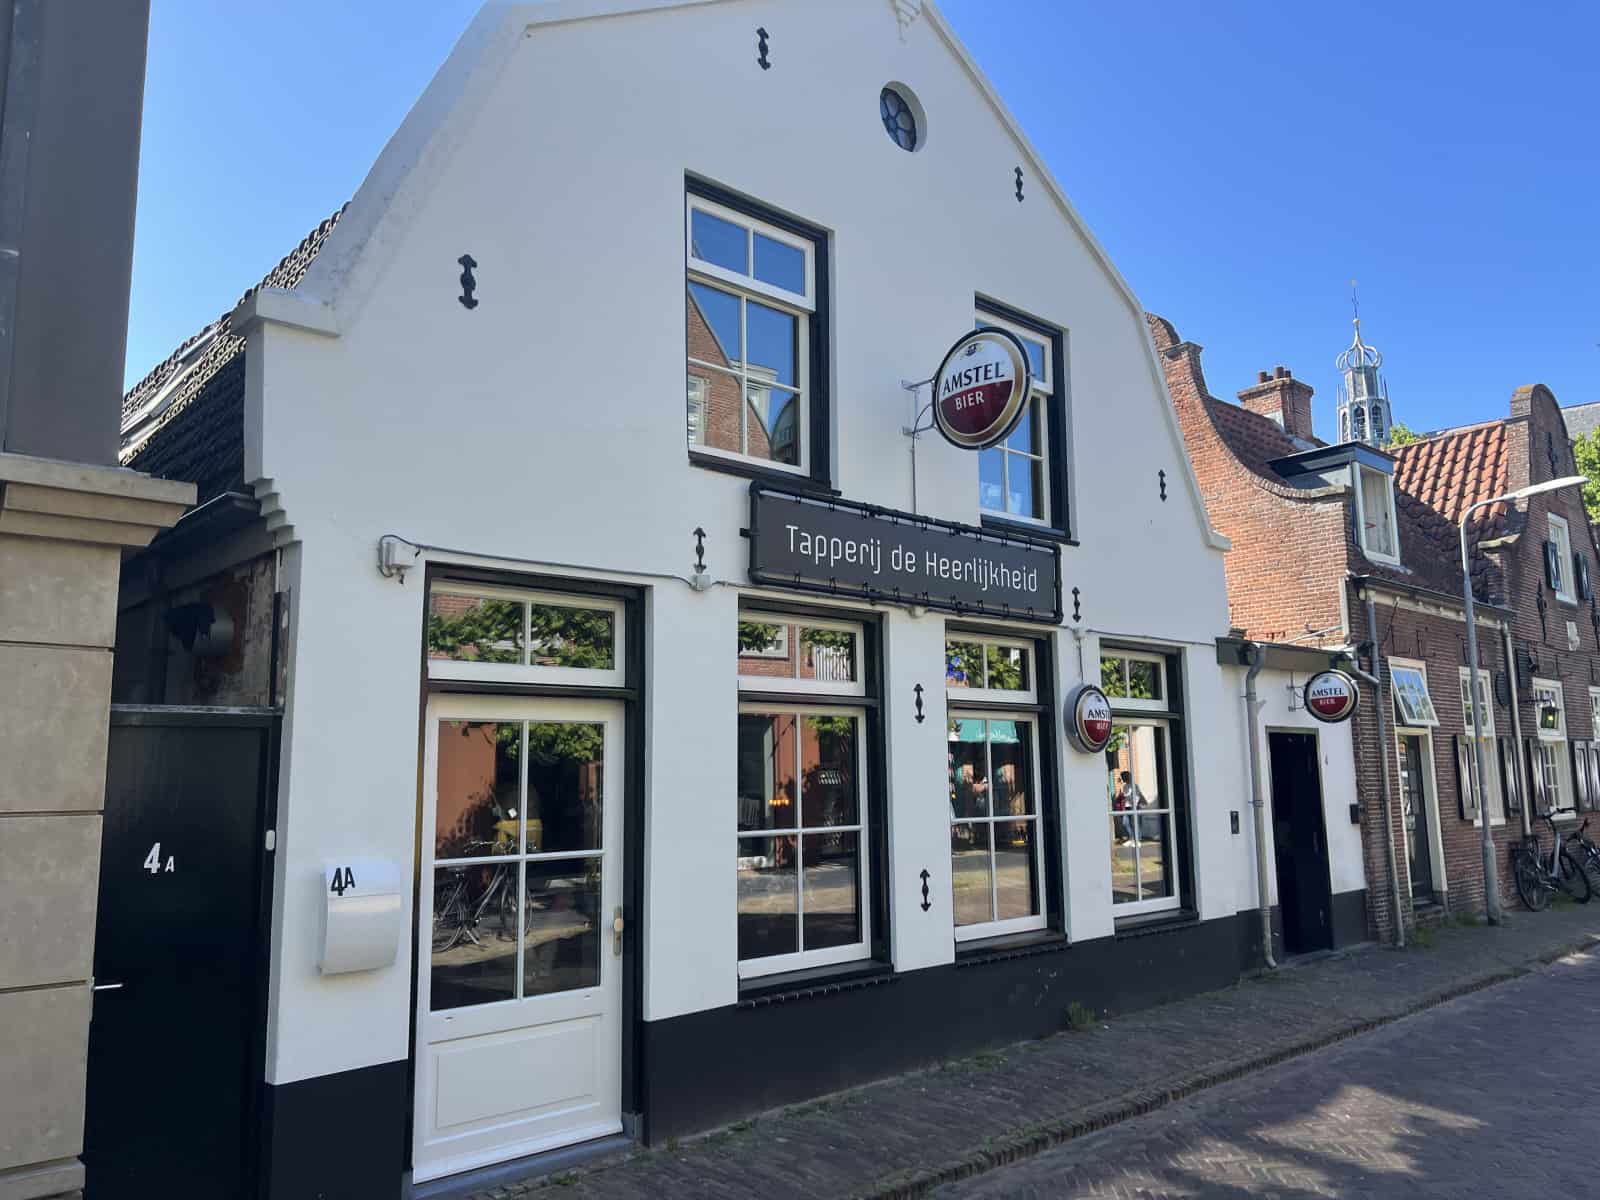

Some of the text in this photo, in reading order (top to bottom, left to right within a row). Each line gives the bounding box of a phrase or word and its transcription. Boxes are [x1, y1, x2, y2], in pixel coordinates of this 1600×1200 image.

[943, 361, 1005, 395] AMSTEL
[955, 391, 985, 411] BIER
[785, 524, 1038, 592] Tapperij de Heerlijkheid
[1312, 687, 1345, 697] AMSTEL
[1087, 708, 1111, 720] AMST
[330, 866, 356, 896] 4A
